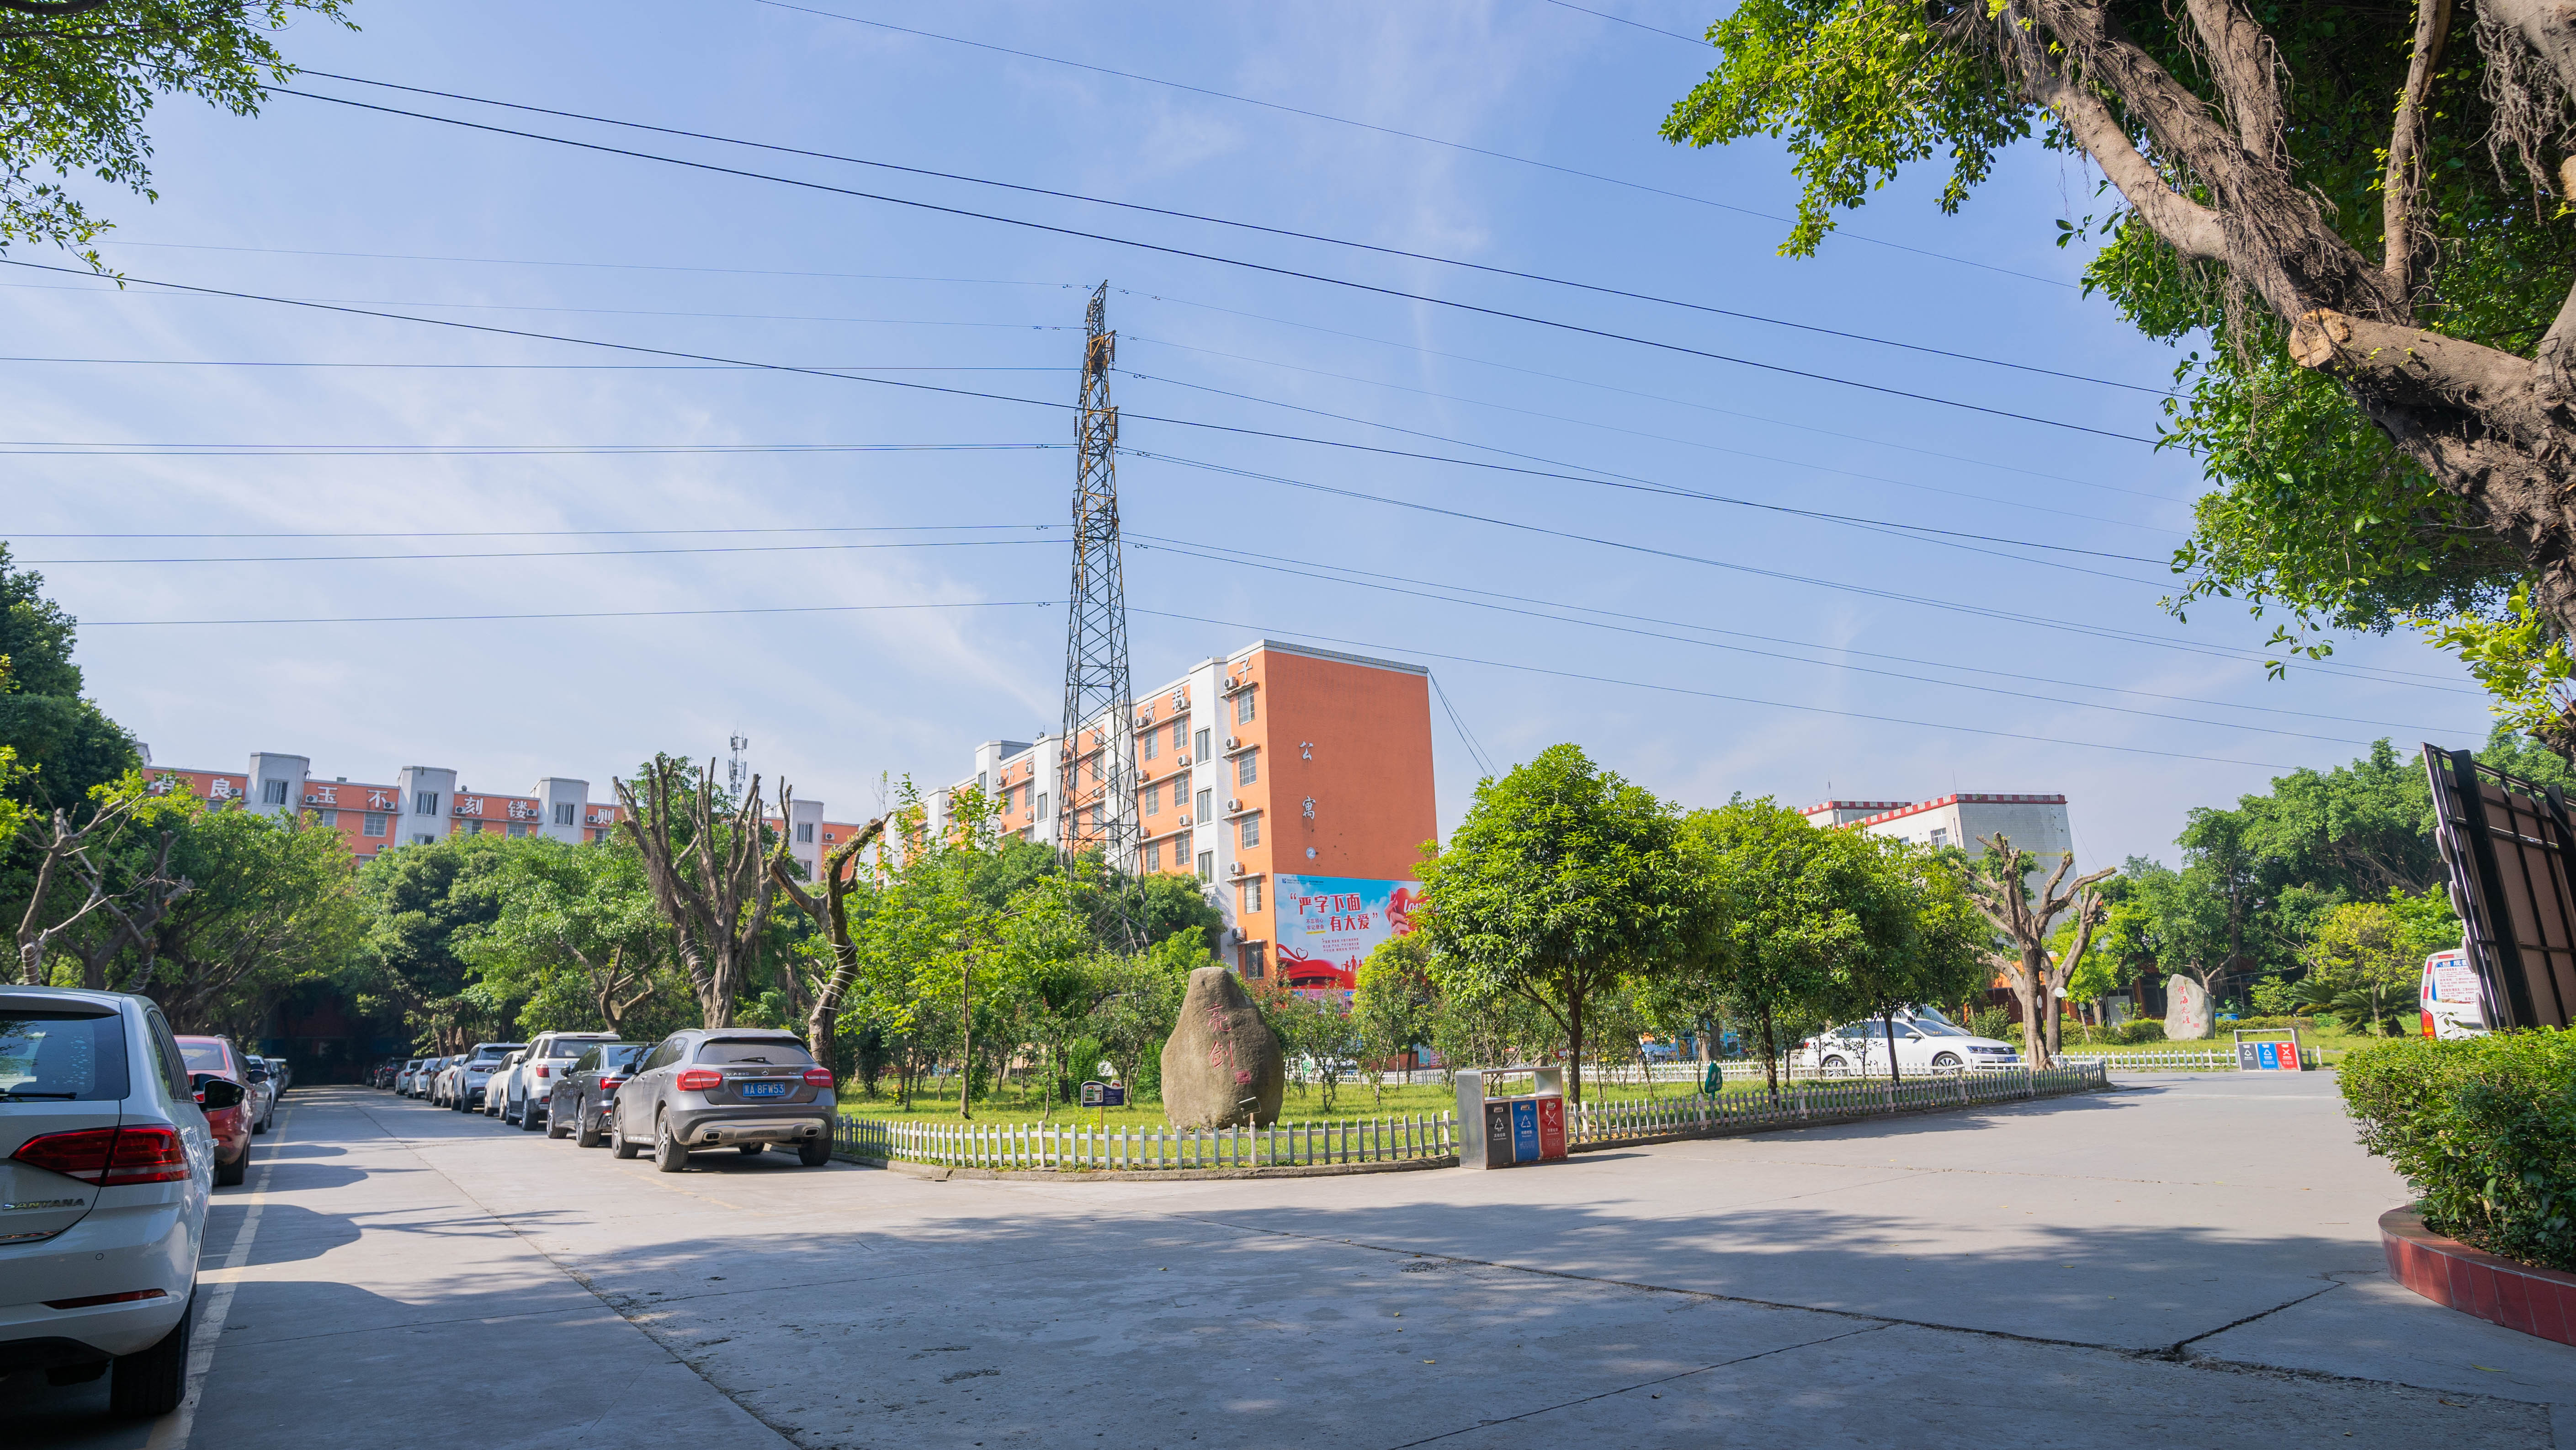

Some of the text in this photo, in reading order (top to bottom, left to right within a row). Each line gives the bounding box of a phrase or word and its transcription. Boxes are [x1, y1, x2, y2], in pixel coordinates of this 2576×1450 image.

[1299, 741, 1316, 820] 公寓
[1205, 1002, 1234, 1069] 亮剑
[3, 1198, 85, 1210] SANTANA
